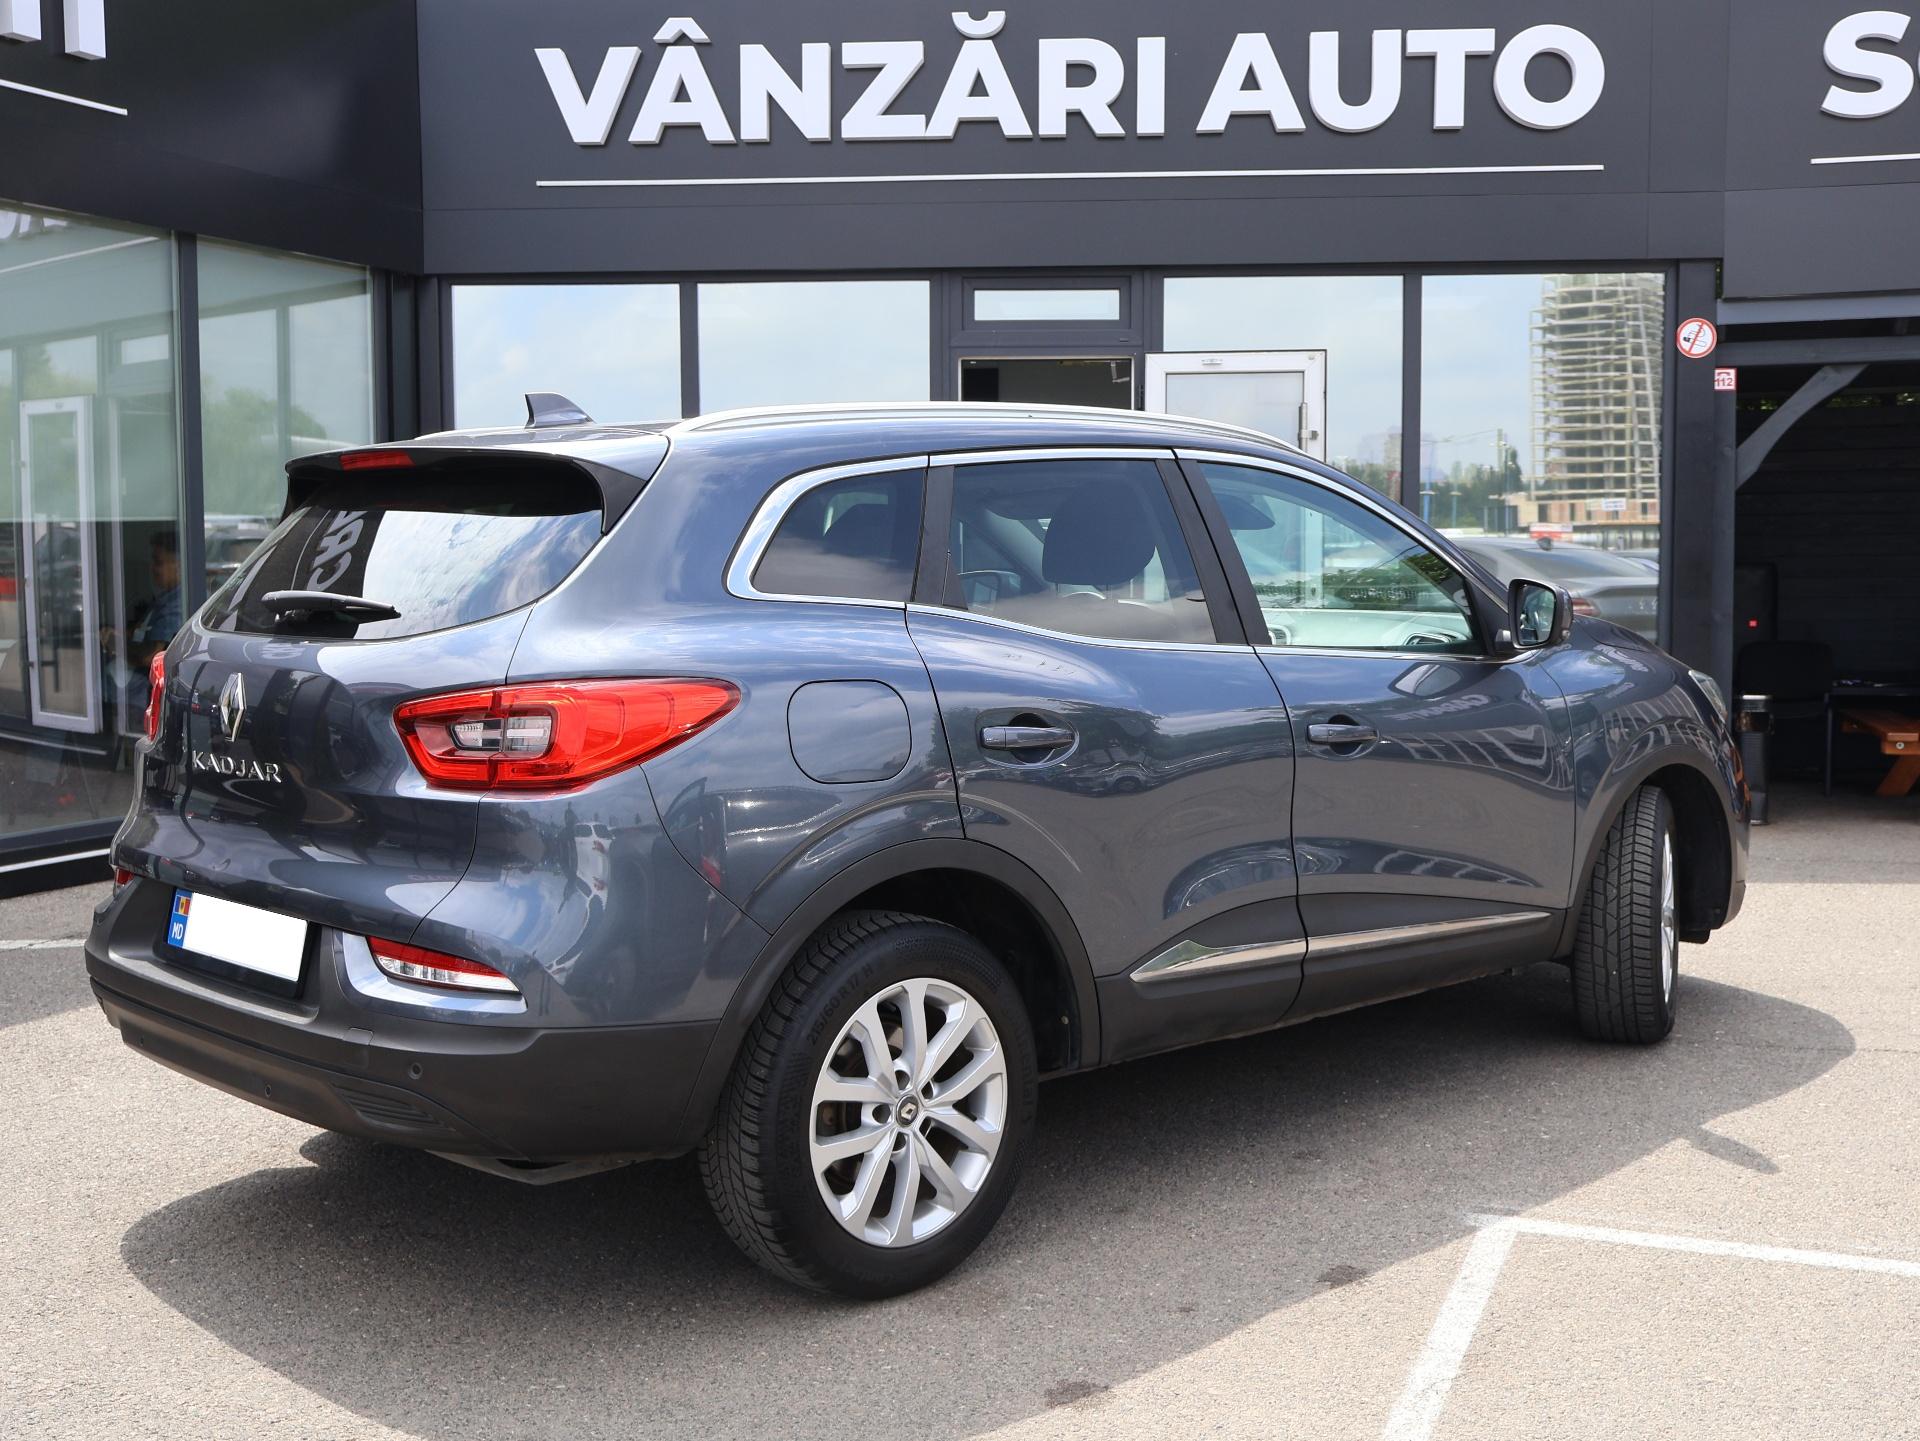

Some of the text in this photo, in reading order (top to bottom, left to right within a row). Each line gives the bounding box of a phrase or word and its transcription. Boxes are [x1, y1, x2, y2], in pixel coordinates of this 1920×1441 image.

[534, 10, 1606, 145] VÂNZĂRI AUTO
[1714, 377, 1733, 387] 112
[192, 750, 282, 783] KADJAR
[171, 922, 184, 940] MD
[806, 996, 841, 1047] 215/60
